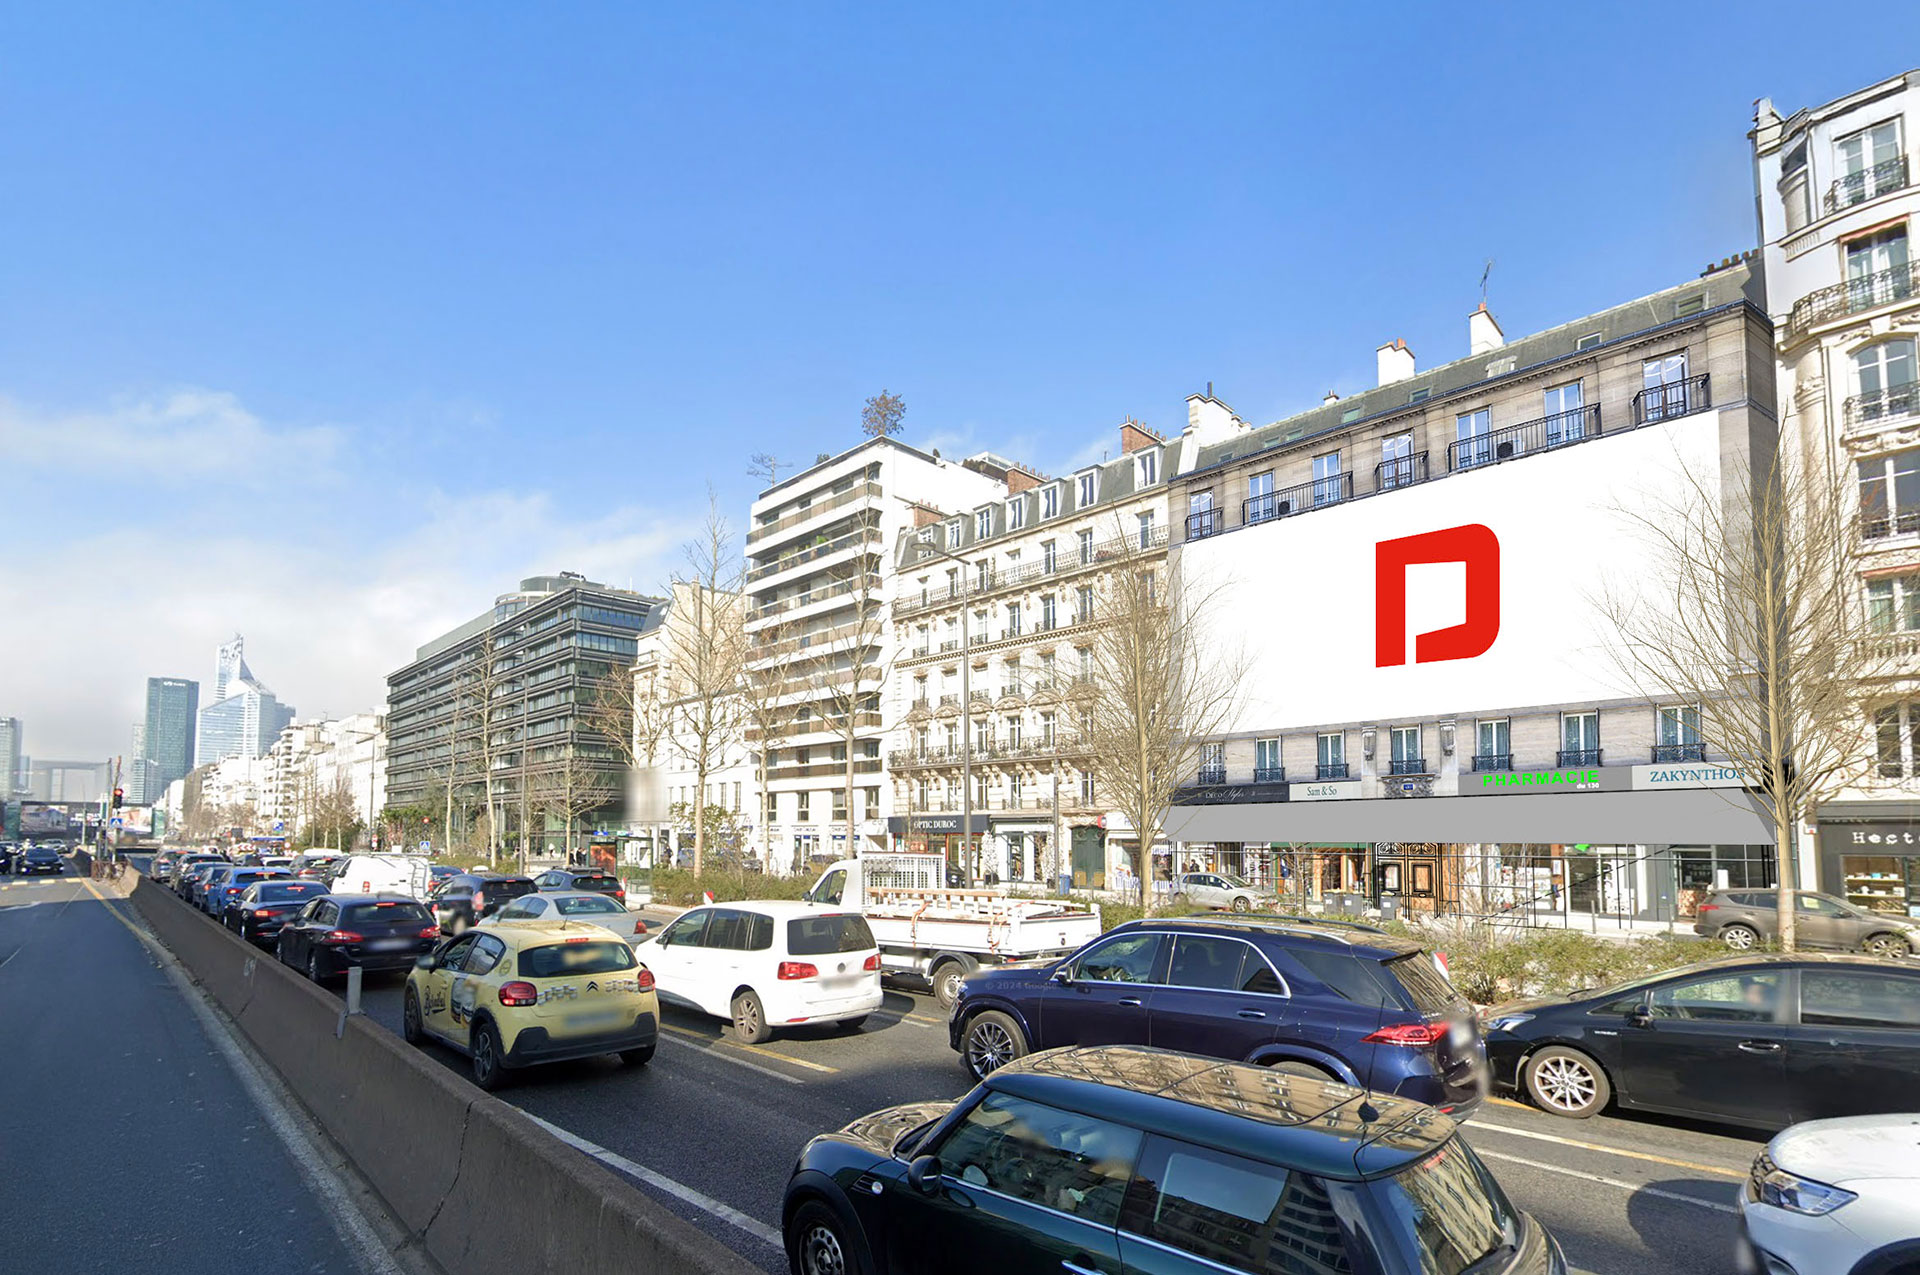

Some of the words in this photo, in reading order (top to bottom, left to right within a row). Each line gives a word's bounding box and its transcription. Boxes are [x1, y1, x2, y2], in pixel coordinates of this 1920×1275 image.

[1483, 770, 1600, 787] PHARMACIE
[1650, 767, 1746, 782] ZAKYNTHOS
[1307, 786, 1321, 796] Sam
[1321, 786, 1328, 796] &
[1328, 785, 1338, 795] So
[913, 820, 933, 829] OPTIC
[933, 820, 957, 829] DUROC
[1852, 831, 1920, 844] Hect
